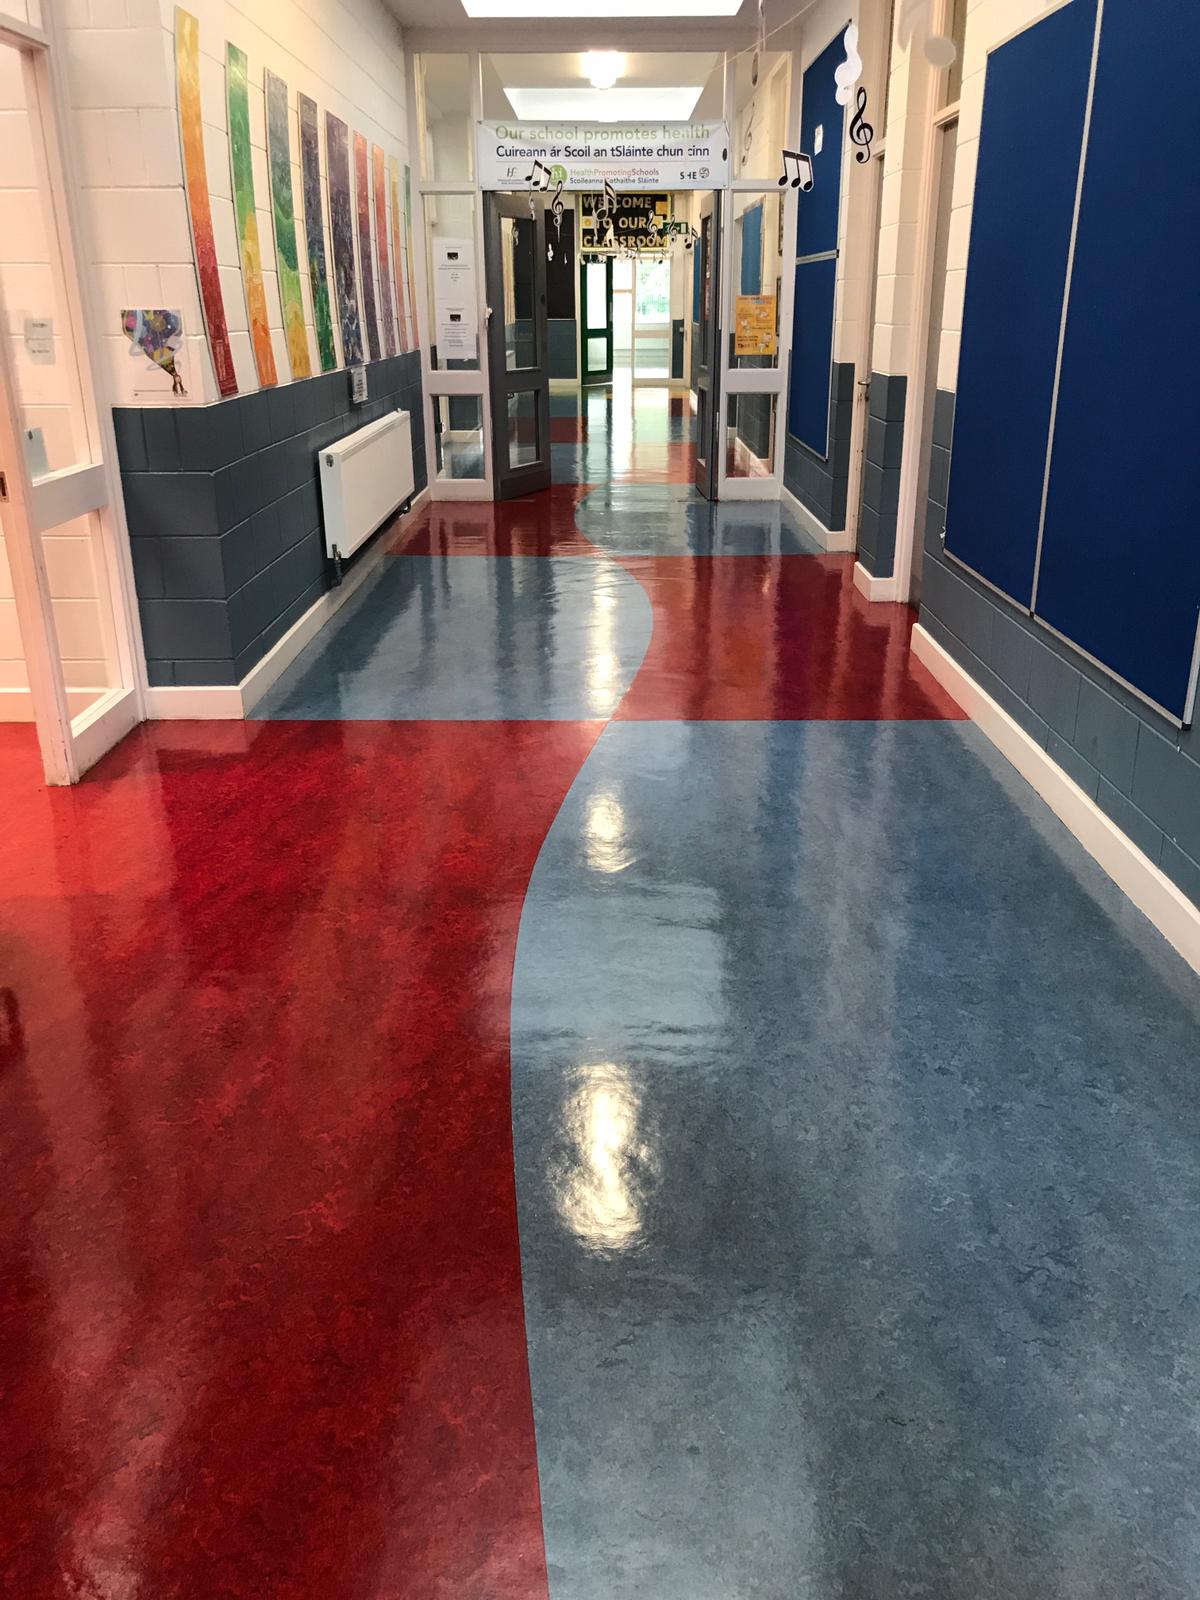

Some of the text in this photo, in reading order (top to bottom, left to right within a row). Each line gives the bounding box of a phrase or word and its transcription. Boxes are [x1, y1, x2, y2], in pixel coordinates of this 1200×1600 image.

[495, 124, 710, 143] Our school promotes health
[496, 144, 710, 157] Cuireann ár Scoil an tSláinte chun cinn
[570, 167, 660, 177] HealthPromotingSchools
[605, 176, 636, 184] othaithe
[618, 217, 647, 229] OUR
